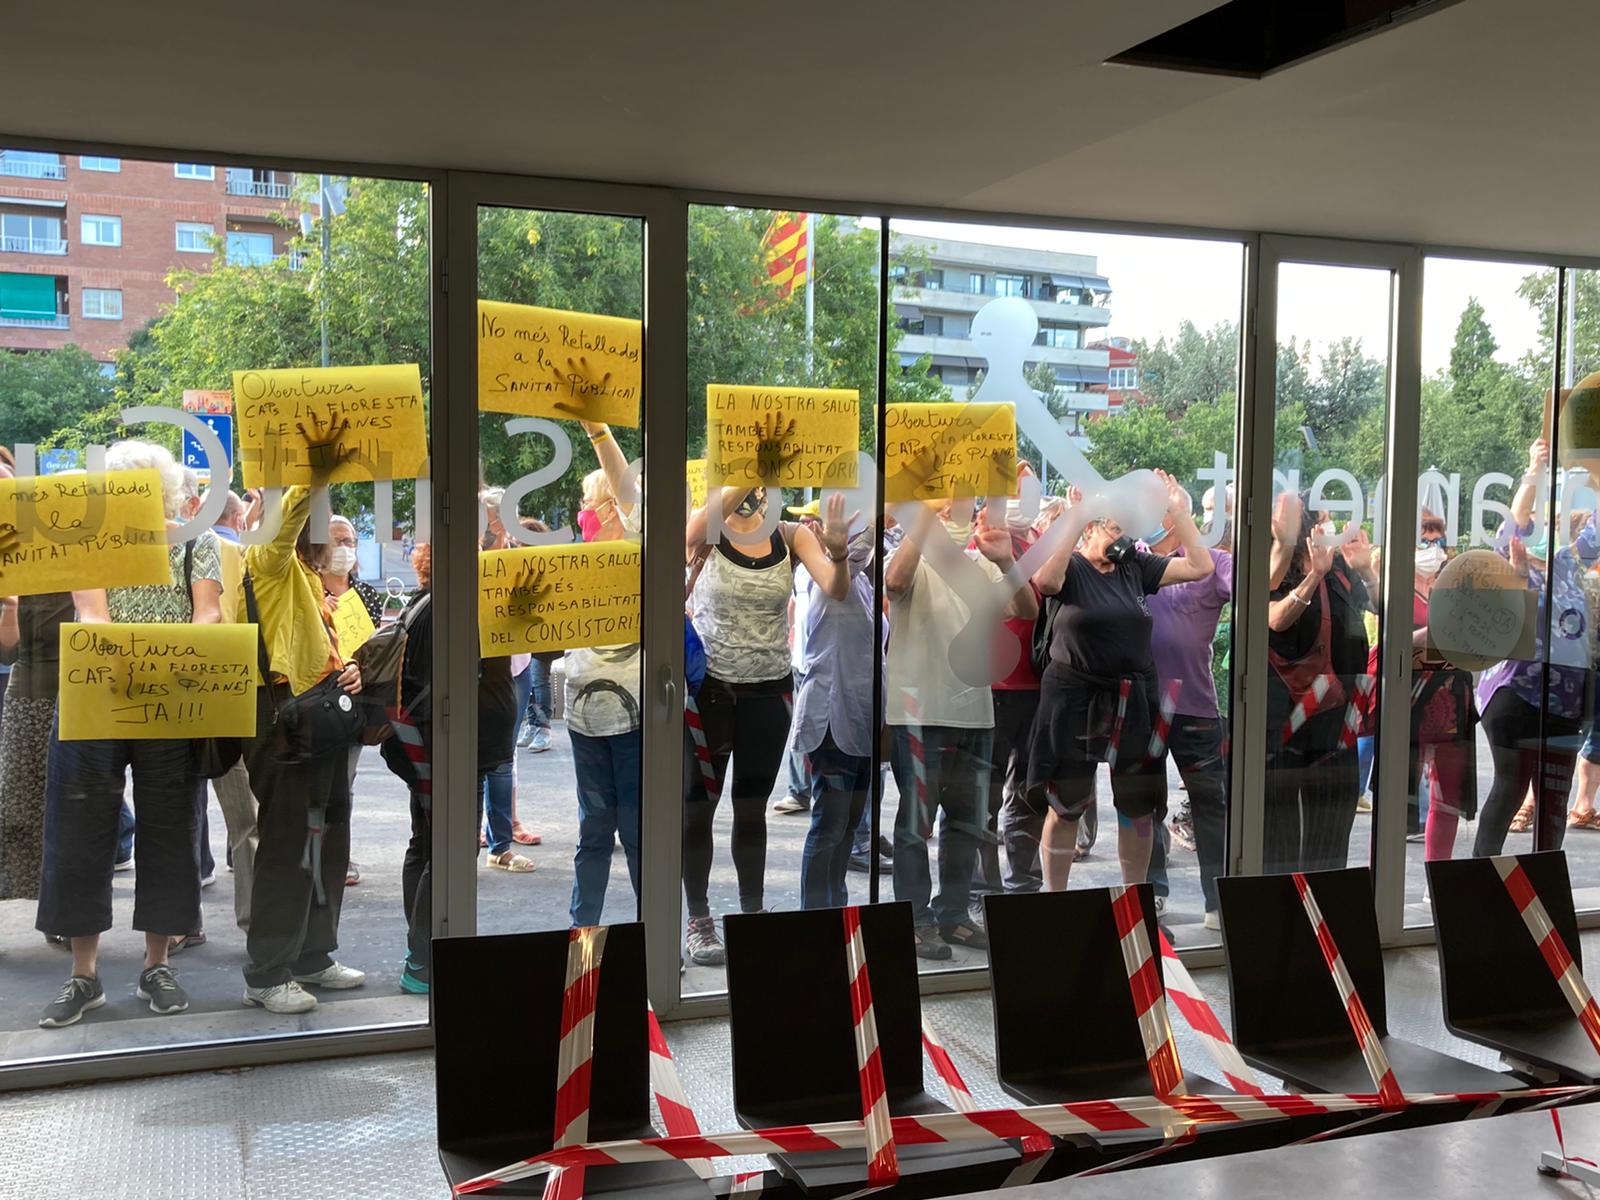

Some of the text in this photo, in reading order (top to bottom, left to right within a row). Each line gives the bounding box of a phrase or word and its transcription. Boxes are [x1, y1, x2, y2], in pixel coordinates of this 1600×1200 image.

[482, 312, 639, 363] No més Retallades
[514, 348, 555, 372] a la
[241, 372, 366, 400] Obertura
[294, 402, 316, 418] LA
[327, 395, 418, 413] FLORESTA
[715, 393, 736, 410] LA
[751, 393, 815, 410] NOSTRA
[265, 420, 306, 436] LES
[315, 416, 393, 432] PLANES
[885, 407, 982, 429] Obertura
[714, 463, 735, 475] DEL
[942, 452, 963, 466] LES
[10, 481, 152, 503] més Retallades
[50, 511, 93, 530] la
[483, 558, 507, 578] LA
[521, 554, 590, 577] NOSTRA
[483, 579, 541, 599] TAMBÉ
[495, 594, 641, 618] RESPONSABILITAT
[69, 628, 208, 658] Obertura
[491, 632, 515, 644] DEL
[139, 662, 158, 672] LA
[169, 663, 250, 677] FLORESTA
[140, 679, 253, 697] LES PLANES
